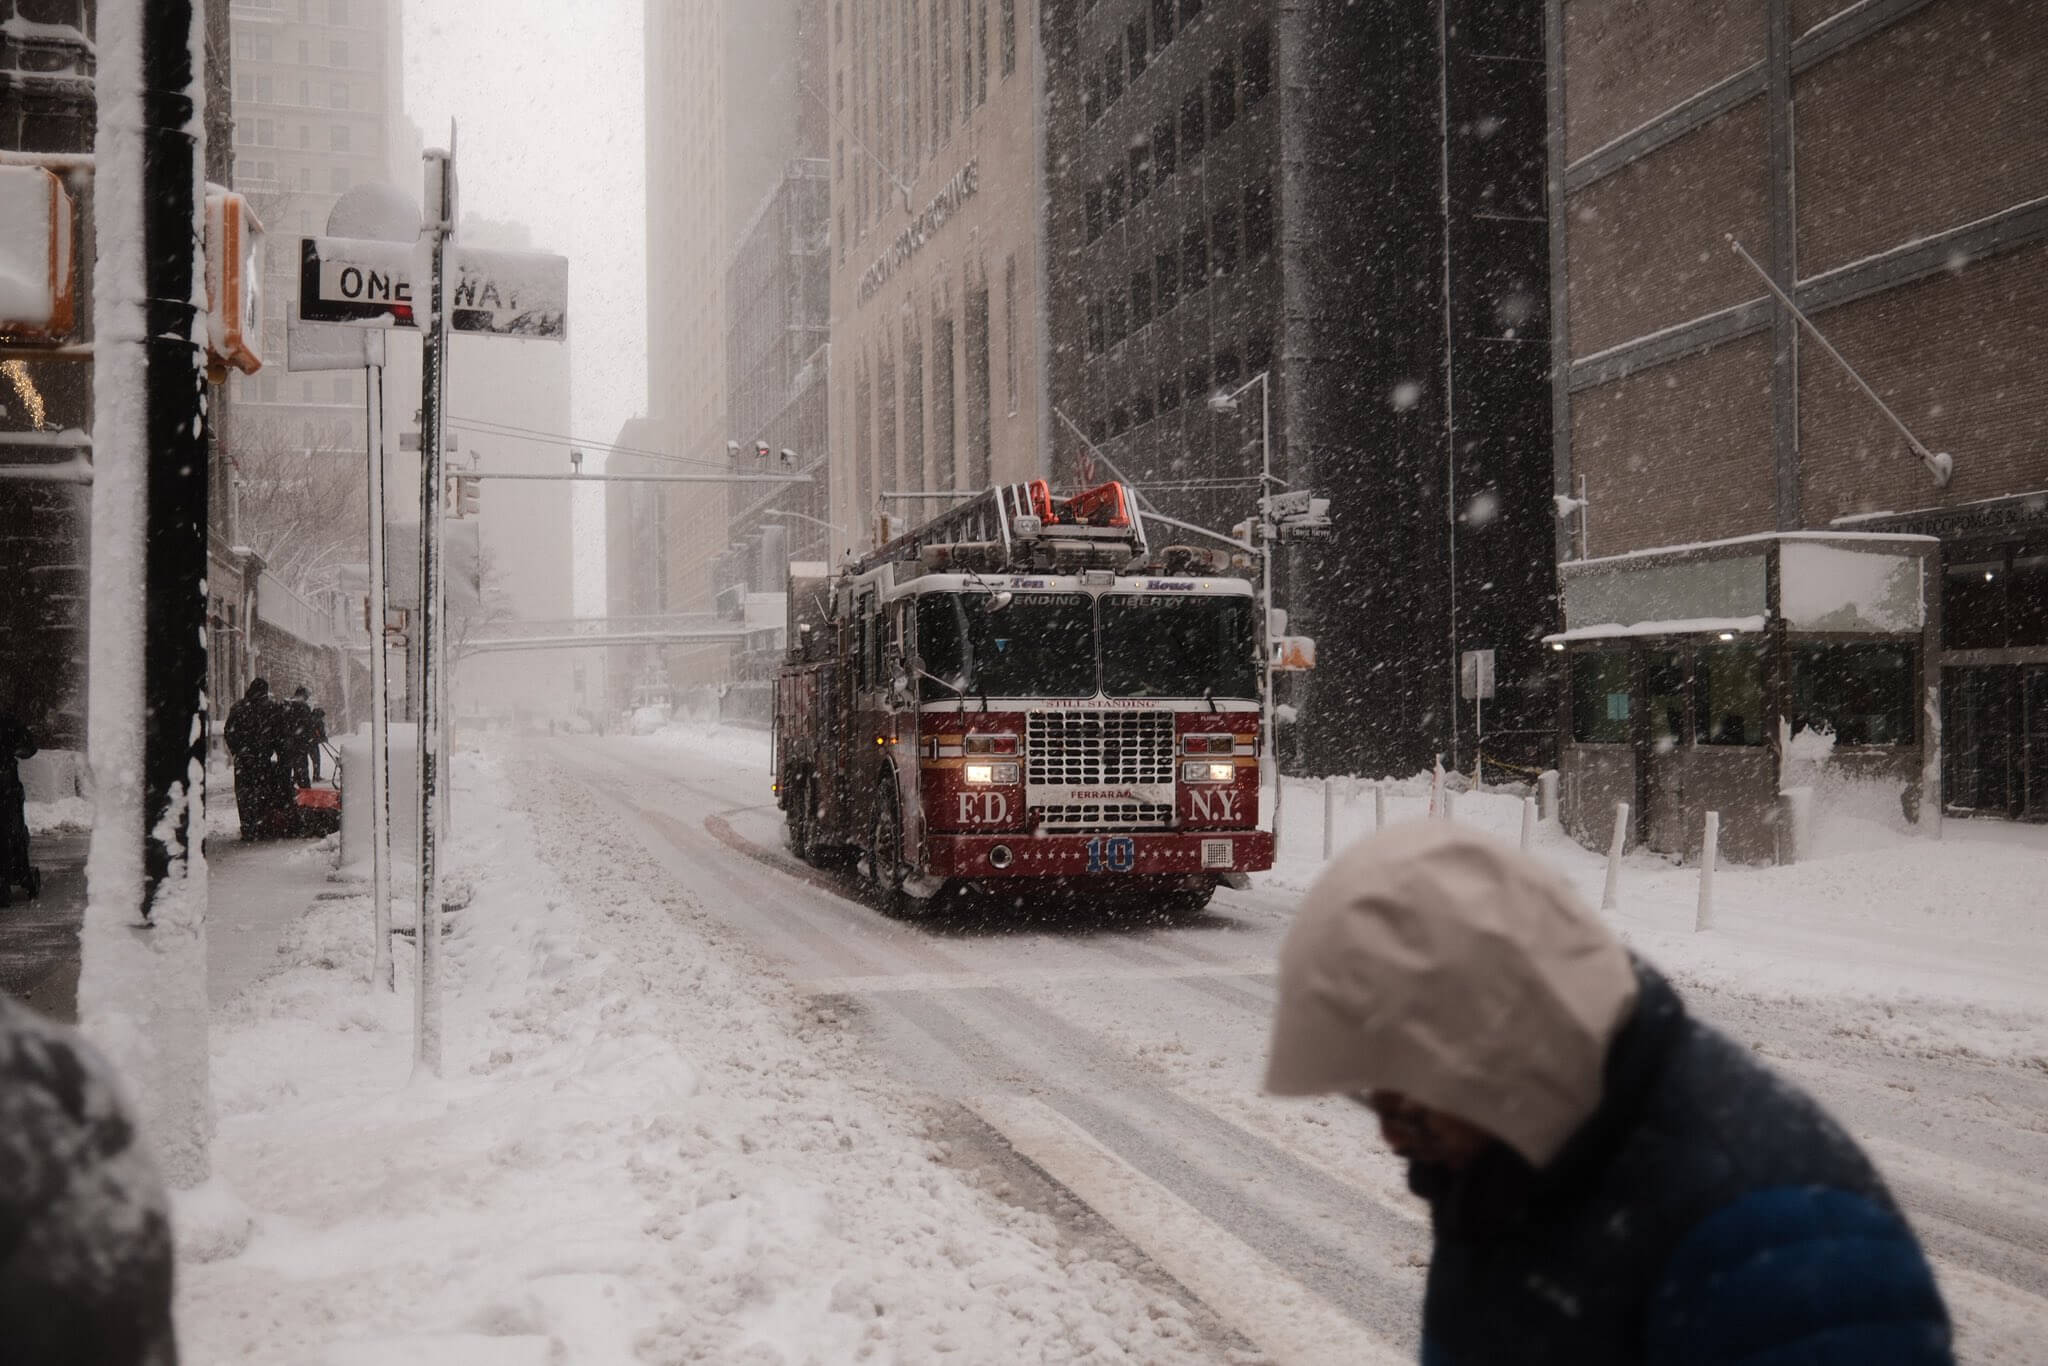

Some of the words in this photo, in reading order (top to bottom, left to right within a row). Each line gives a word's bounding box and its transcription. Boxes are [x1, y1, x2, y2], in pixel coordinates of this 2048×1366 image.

[340, 267, 413, 302] ONE
[1010, 577, 1045, 589] Ten
[1147, 579, 1195, 591] House
[956, 791, 1013, 823] F.D.
[1071, 790, 1125, 799] FERRARA
[1188, 789, 1242, 821] N.Y.
[1085, 836, 1135, 872] 10
